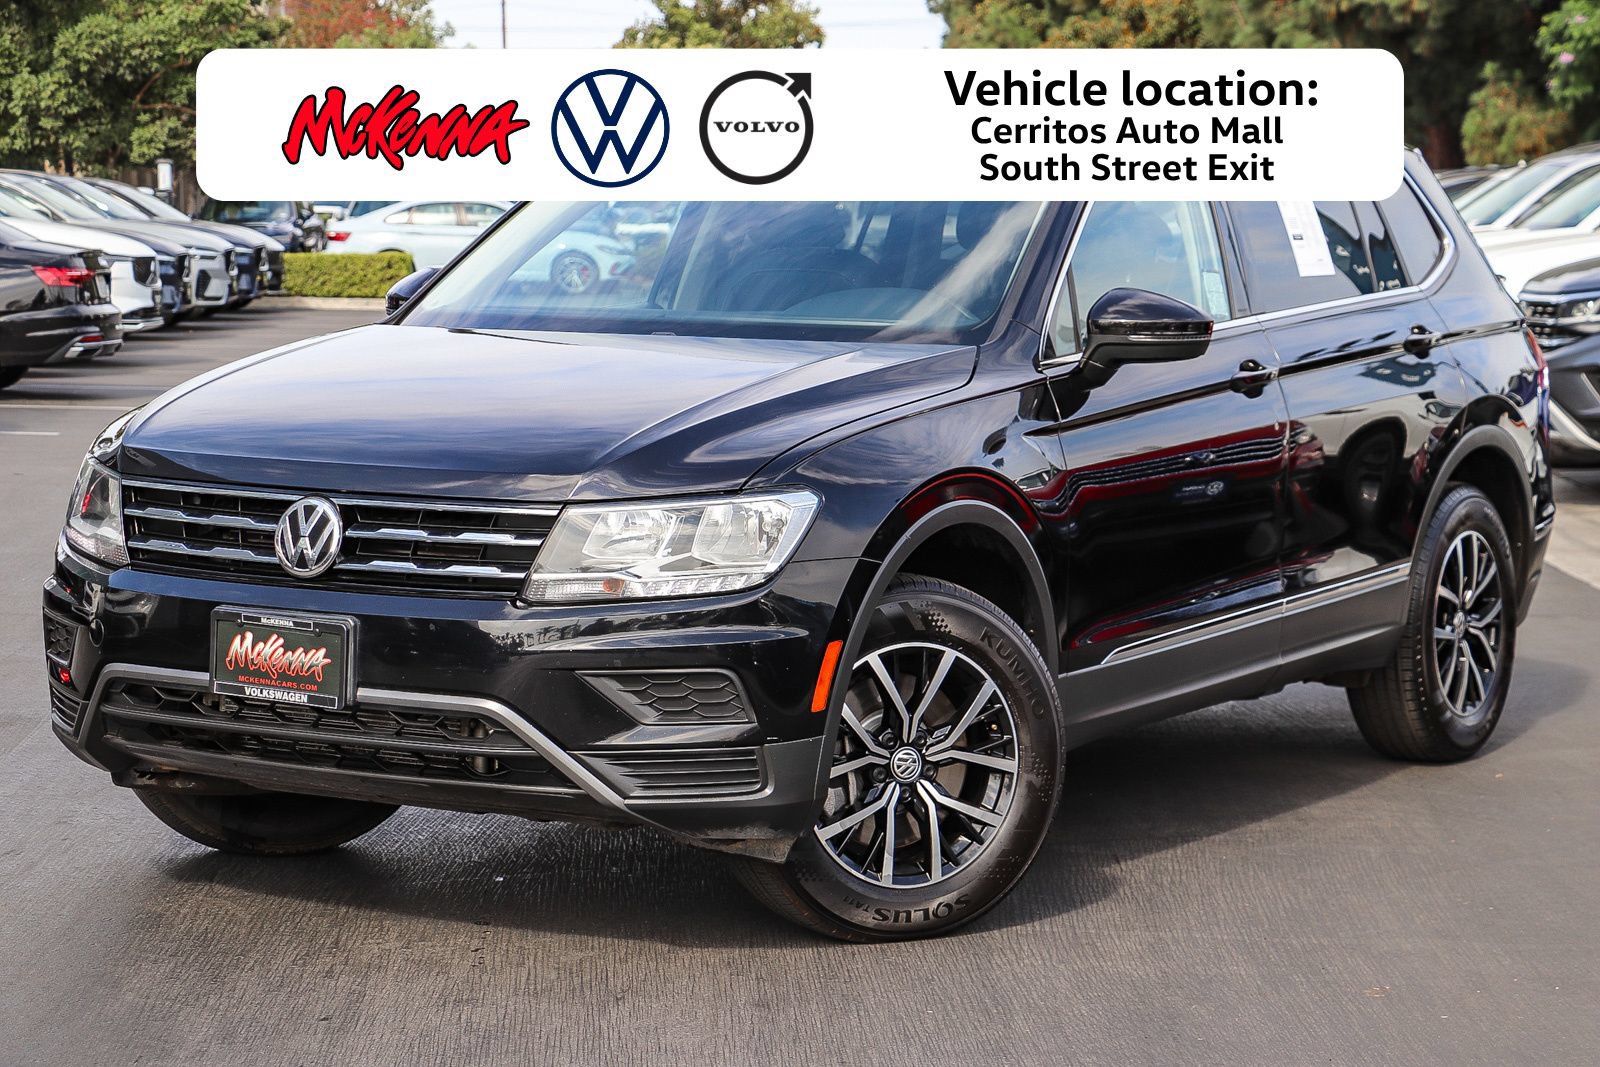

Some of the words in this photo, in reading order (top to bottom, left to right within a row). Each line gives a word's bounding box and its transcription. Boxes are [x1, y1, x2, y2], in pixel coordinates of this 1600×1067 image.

[238, 675, 318, 691] MCKENNACARS.COM
[979, 626, 1045, 719] KUMHO
[244, 686, 308, 703] VOLKSWAGEN
[872, 894, 970, 923] SOLUS
